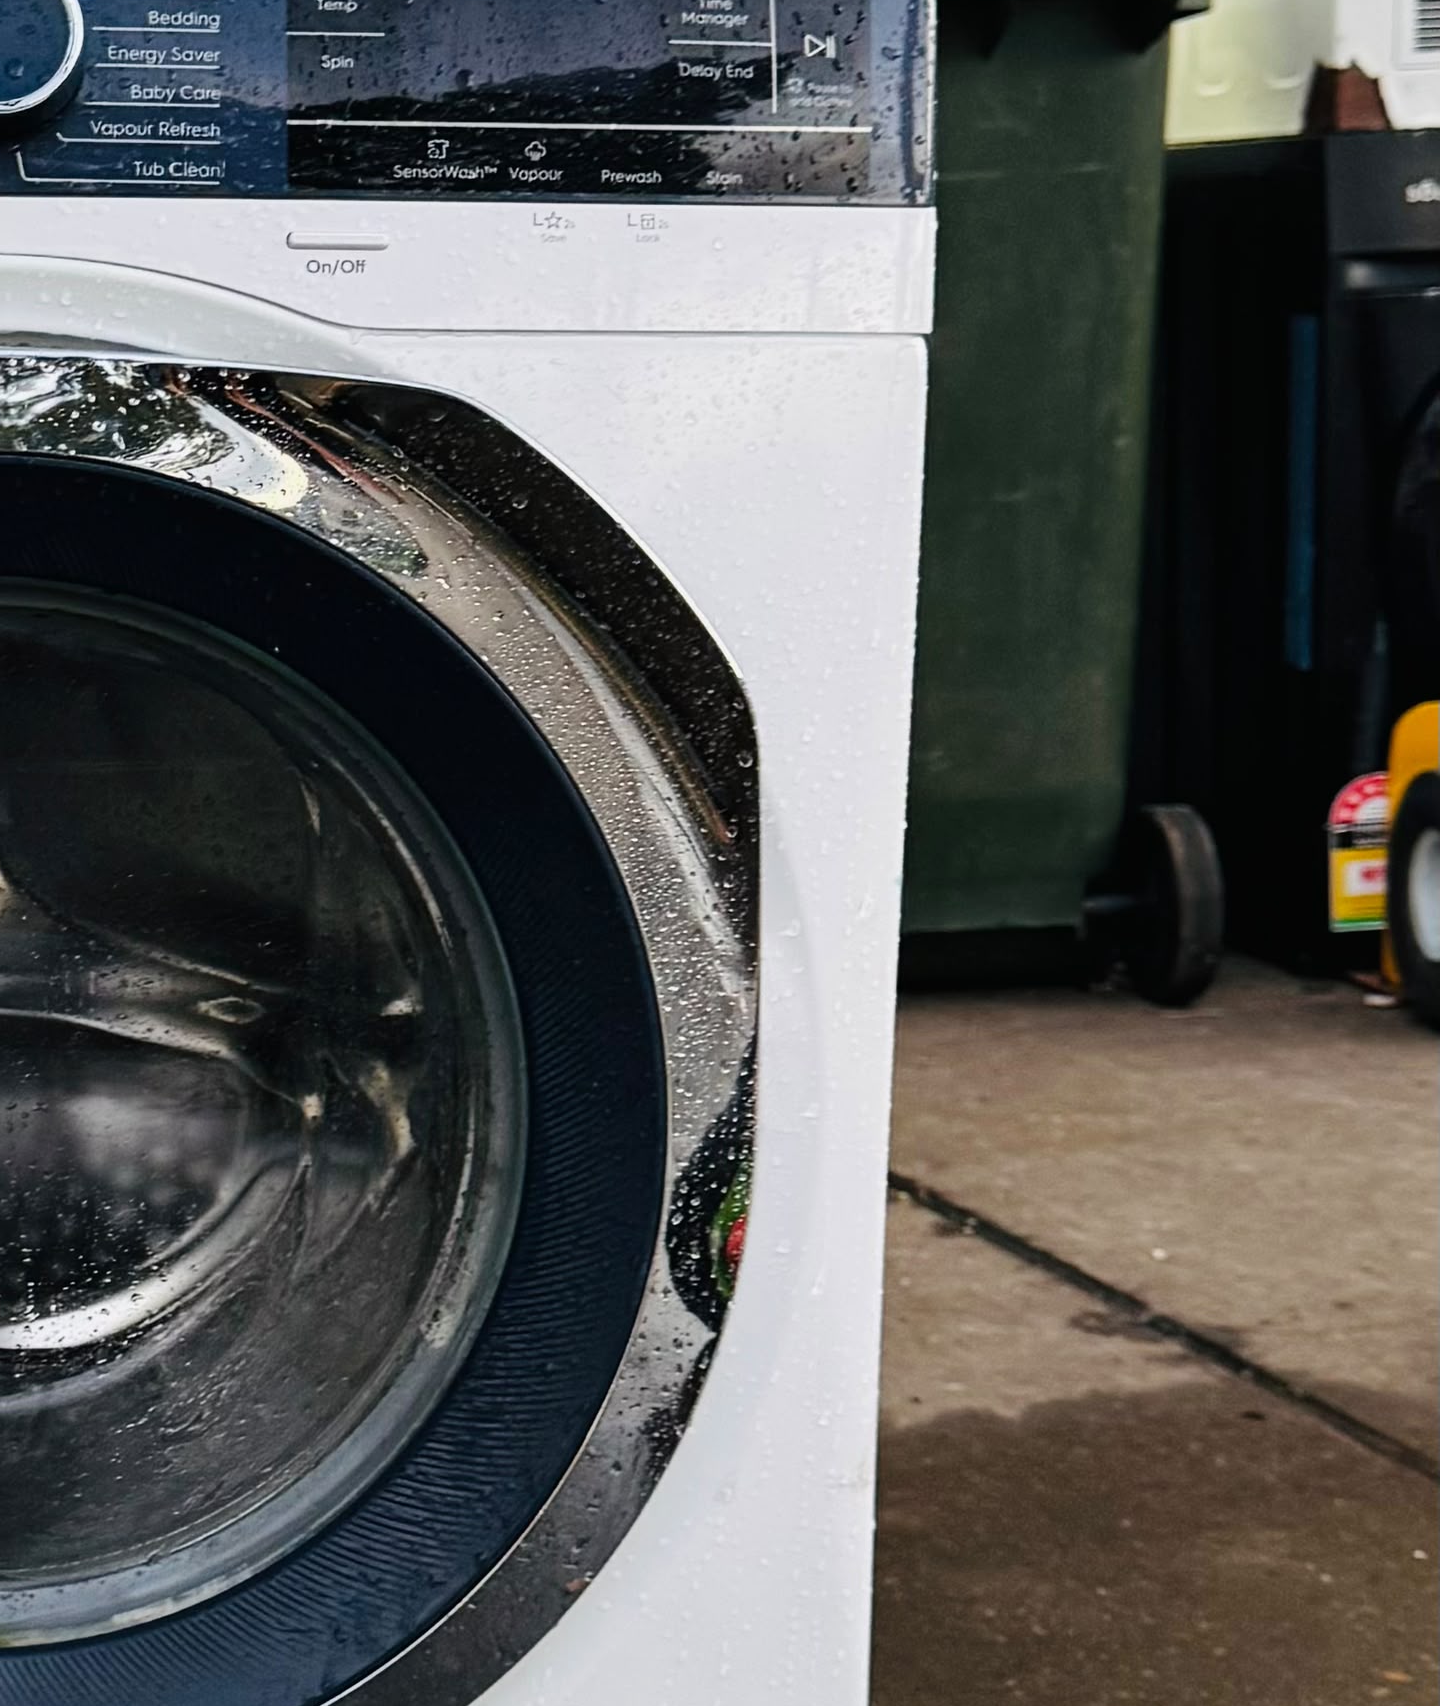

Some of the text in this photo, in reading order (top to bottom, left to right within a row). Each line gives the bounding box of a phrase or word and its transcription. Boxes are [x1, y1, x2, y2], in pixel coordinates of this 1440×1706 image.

[148, 11, 221, 28] Bedding
[681, 12, 749, 27] Manager
[108, 46, 220, 62] Energy Saver
[320, 55, 354, 69] Spin
[679, 63, 754, 79] Delay End
[130, 85, 221, 101] Baby Care
[91, 120, 221, 138] Vapour Refresh
[133, 161, 221, 177] Tub Clean
[509, 167, 563, 183] Vapour
[601, 169, 662, 184] Prewash
[706, 171, 743, 185] Stain
[306, 260, 366, 274] On/Off
